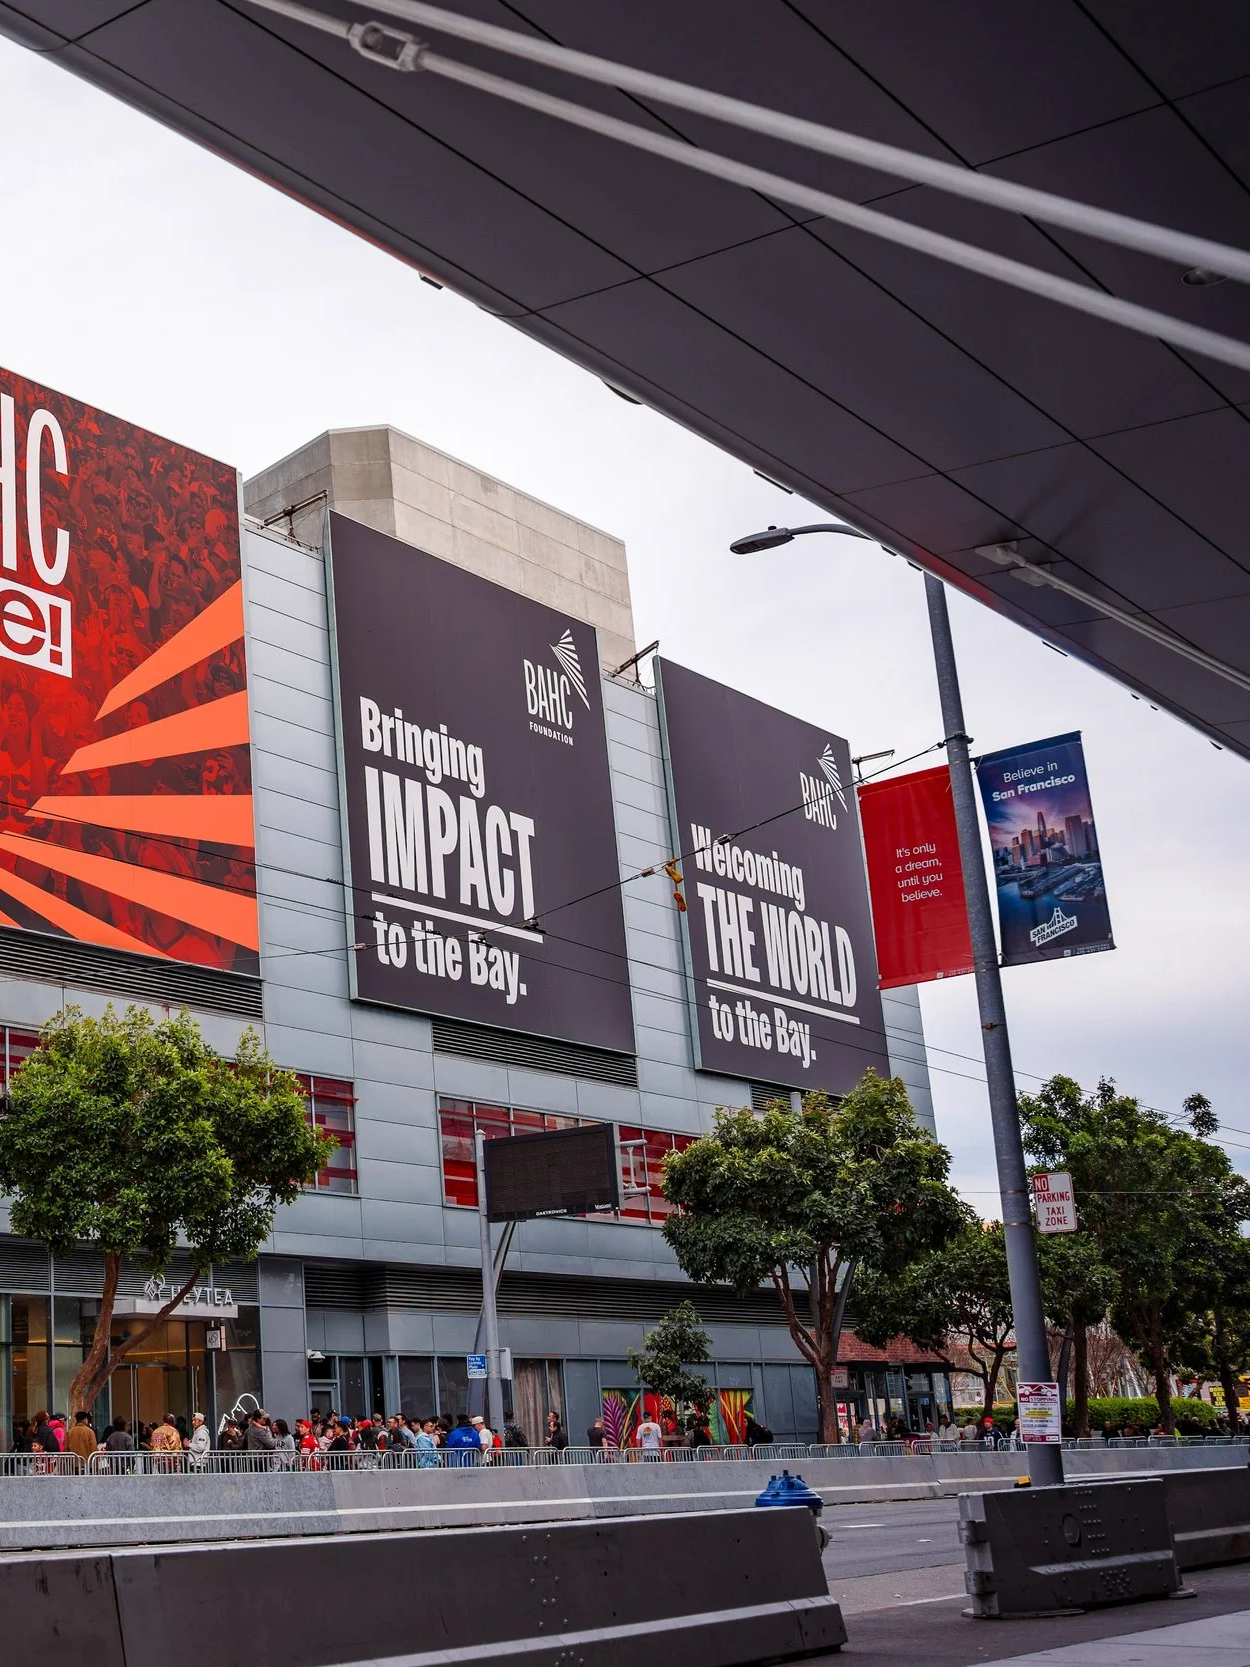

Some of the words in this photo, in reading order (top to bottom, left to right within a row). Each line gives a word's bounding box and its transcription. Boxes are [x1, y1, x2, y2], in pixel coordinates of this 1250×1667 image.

[523, 659, 574, 730] BAHC
[529, 721, 574, 746] FOUNDATION
[359, 695, 486, 799] Bringing
[1003, 764, 1045, 783] Believe
[1047, 761, 1058, 773] in
[992, 788, 1015, 801] San
[1017, 774, 1075, 794] Francisco
[799, 771, 837, 831] BAHC
[365, 765, 535, 920] IMPACT
[896, 848, 911, 858] It's
[913, 842, 936, 856] only
[690, 823, 806, 912] Welcoming
[895, 865, 902, 874] a
[905, 857, 942, 872] dream,
[897, 876, 919, 888] until
[922, 873, 943, 885] you
[901, 888, 943, 903] believe.
[1032, 926, 1046, 939] SAN
[1036, 919, 1076, 944] FRANCISCO
[696, 882, 761, 983] THE
[760, 901, 857, 1008] WORLD
[373, 911, 407, 969] to
[412, 920, 462, 982] the
[468, 931, 527, 1005] Bay.
[708, 994, 735, 1042] to
[735, 1000, 772, 1050] the
[774, 1007, 817, 1069] Bay.
[1035, 1177, 1048, 1191] NO
[1037, 1191, 1071, 1203] PARKING
[1045, 1216, 1068, 1226] ZONE
[1046, 1206, 1065, 1215] TAXI
